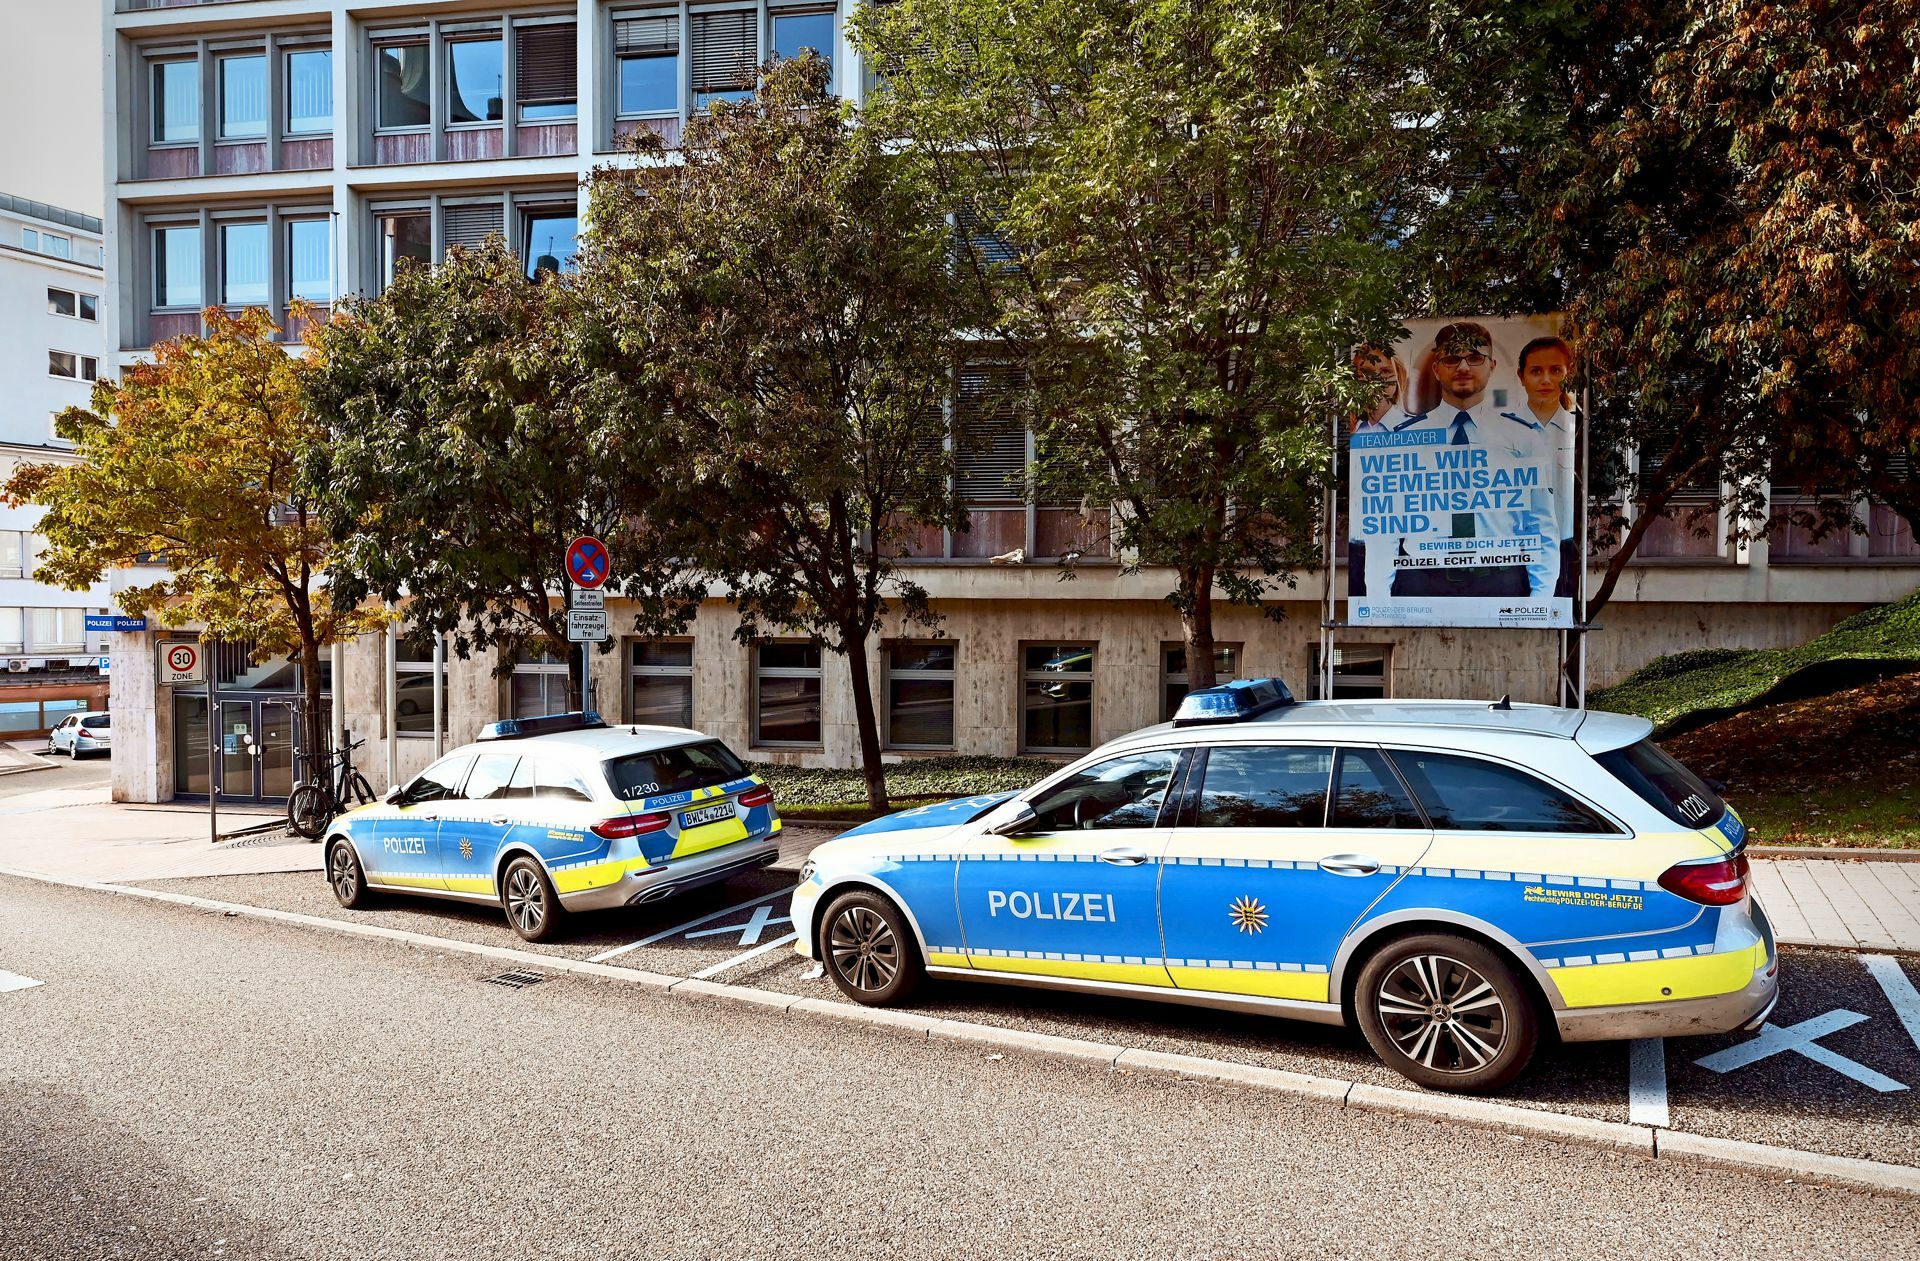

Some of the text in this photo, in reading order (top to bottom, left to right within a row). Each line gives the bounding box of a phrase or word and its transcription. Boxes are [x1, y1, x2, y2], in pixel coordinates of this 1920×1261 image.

[1360, 432, 1437, 447] TEAMPLAYER
[1360, 450, 1488, 473] WEIL WIR
[1361, 467, 1538, 494] GEMEINSAM
[1362, 489, 1524, 514] IM EINSATZ
[1362, 514, 1438, 535] SIND.
[1419, 538, 1537, 551] BEWIRB DICH JETZT!
[1393, 554, 1535, 567] POLIZEI. ECHT. WICHTIG.
[571, 622, 604, 630] fahrzeuge
[582, 630, 594, 638] frei
[173, 652, 191, 665] 30
[171, 673, 193, 681] ZONE
[623, 782, 660, 798] 1/230
[651, 794, 686, 806] POLIZEI
[1677, 794, 1710, 822] 1/220
[383, 837, 426, 854] POLIZEI
[1545, 889, 1643, 903] BEWIRB DICH JETZT!
[988, 890, 1116, 923] POLIZEI
